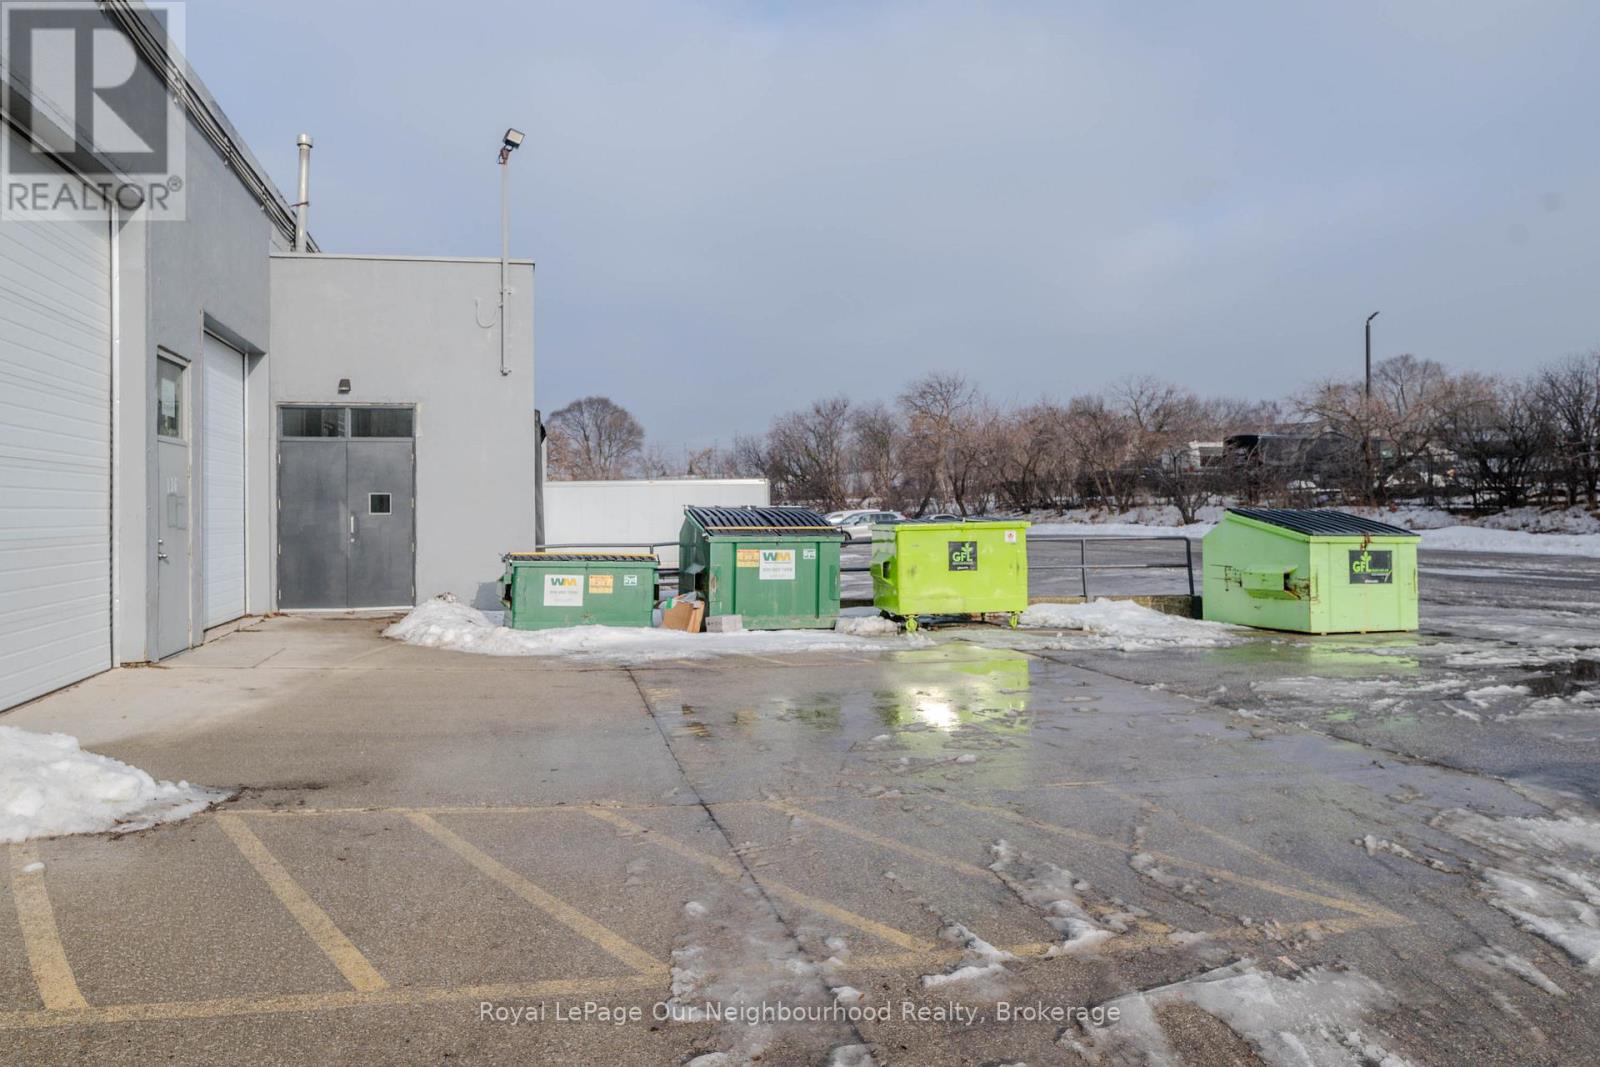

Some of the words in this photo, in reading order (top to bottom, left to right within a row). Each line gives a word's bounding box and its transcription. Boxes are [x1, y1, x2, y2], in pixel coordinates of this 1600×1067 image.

[763, 552, 791, 561] WM
[952, 551, 973, 562] GFL
[1353, 560, 1371, 573] GFL
[551, 578, 577, 587] WM
